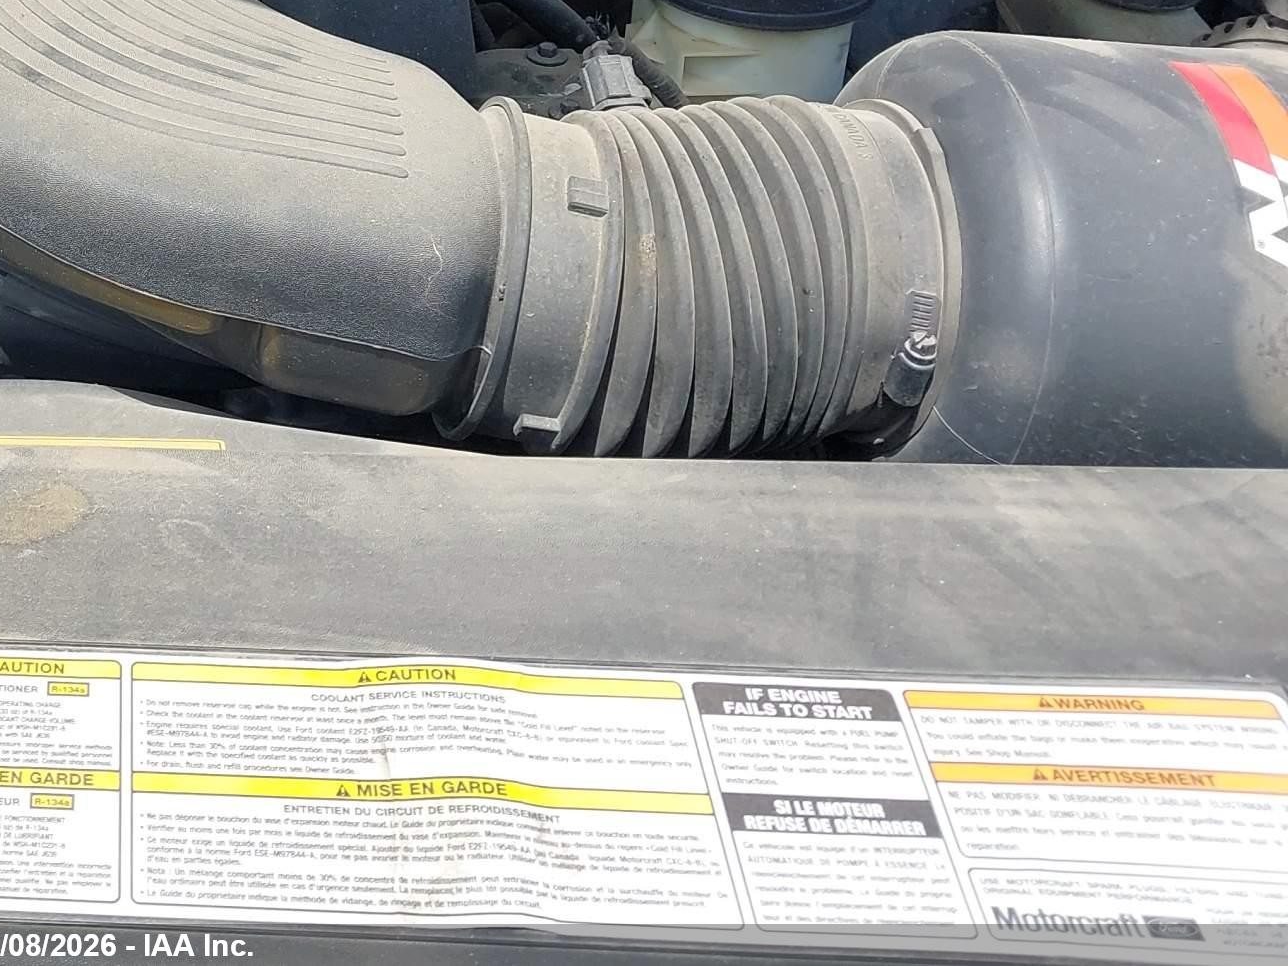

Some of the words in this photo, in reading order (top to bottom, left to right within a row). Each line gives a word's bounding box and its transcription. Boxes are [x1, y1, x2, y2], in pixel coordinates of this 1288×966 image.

[376, 669, 456, 681] CAUTION
[51, 686, 86, 694] R-134a
[311, 694, 364, 702] COOLANT
[368, 690, 417, 700] SERVICE
[422, 690, 506, 704] INSTRUCTIONS
[745, 688, 764, 700] IF
[767, 689, 842, 704] ENGINE
[722, 702, 777, 716] FAILS
[779, 702, 809, 717] TO
[812, 704, 872, 720] START
[1052, 698, 1145, 712] WARNING
[0, 771, 22, 784] EN
[30, 772, 94, 786] GARDE
[1052, 769, 1216, 788] AVERTISSEMENT
[356, 783, 403, 797] MISE
[410, 782, 434, 795] EN
[442, 781, 508, 796] GARDE
[34, 798, 70, 808] R-134a
[773, 800, 791, 814] SI
[794, 800, 814, 816] LE
[816, 802, 886, 818] MOTEUR
[284, 804, 350, 816] ENTRETIEN
[354, 807, 371, 816] DU
[376, 806, 423, 816] CIRCUIT
[428, 806, 444, 814] DE
[448, 804, 560, 823] REFROIDISSEMENT
[744, 815, 807, 832] REFUSE
[808, 817, 834, 834] DE
[991, 906, 1145, 938] Motorcraft
